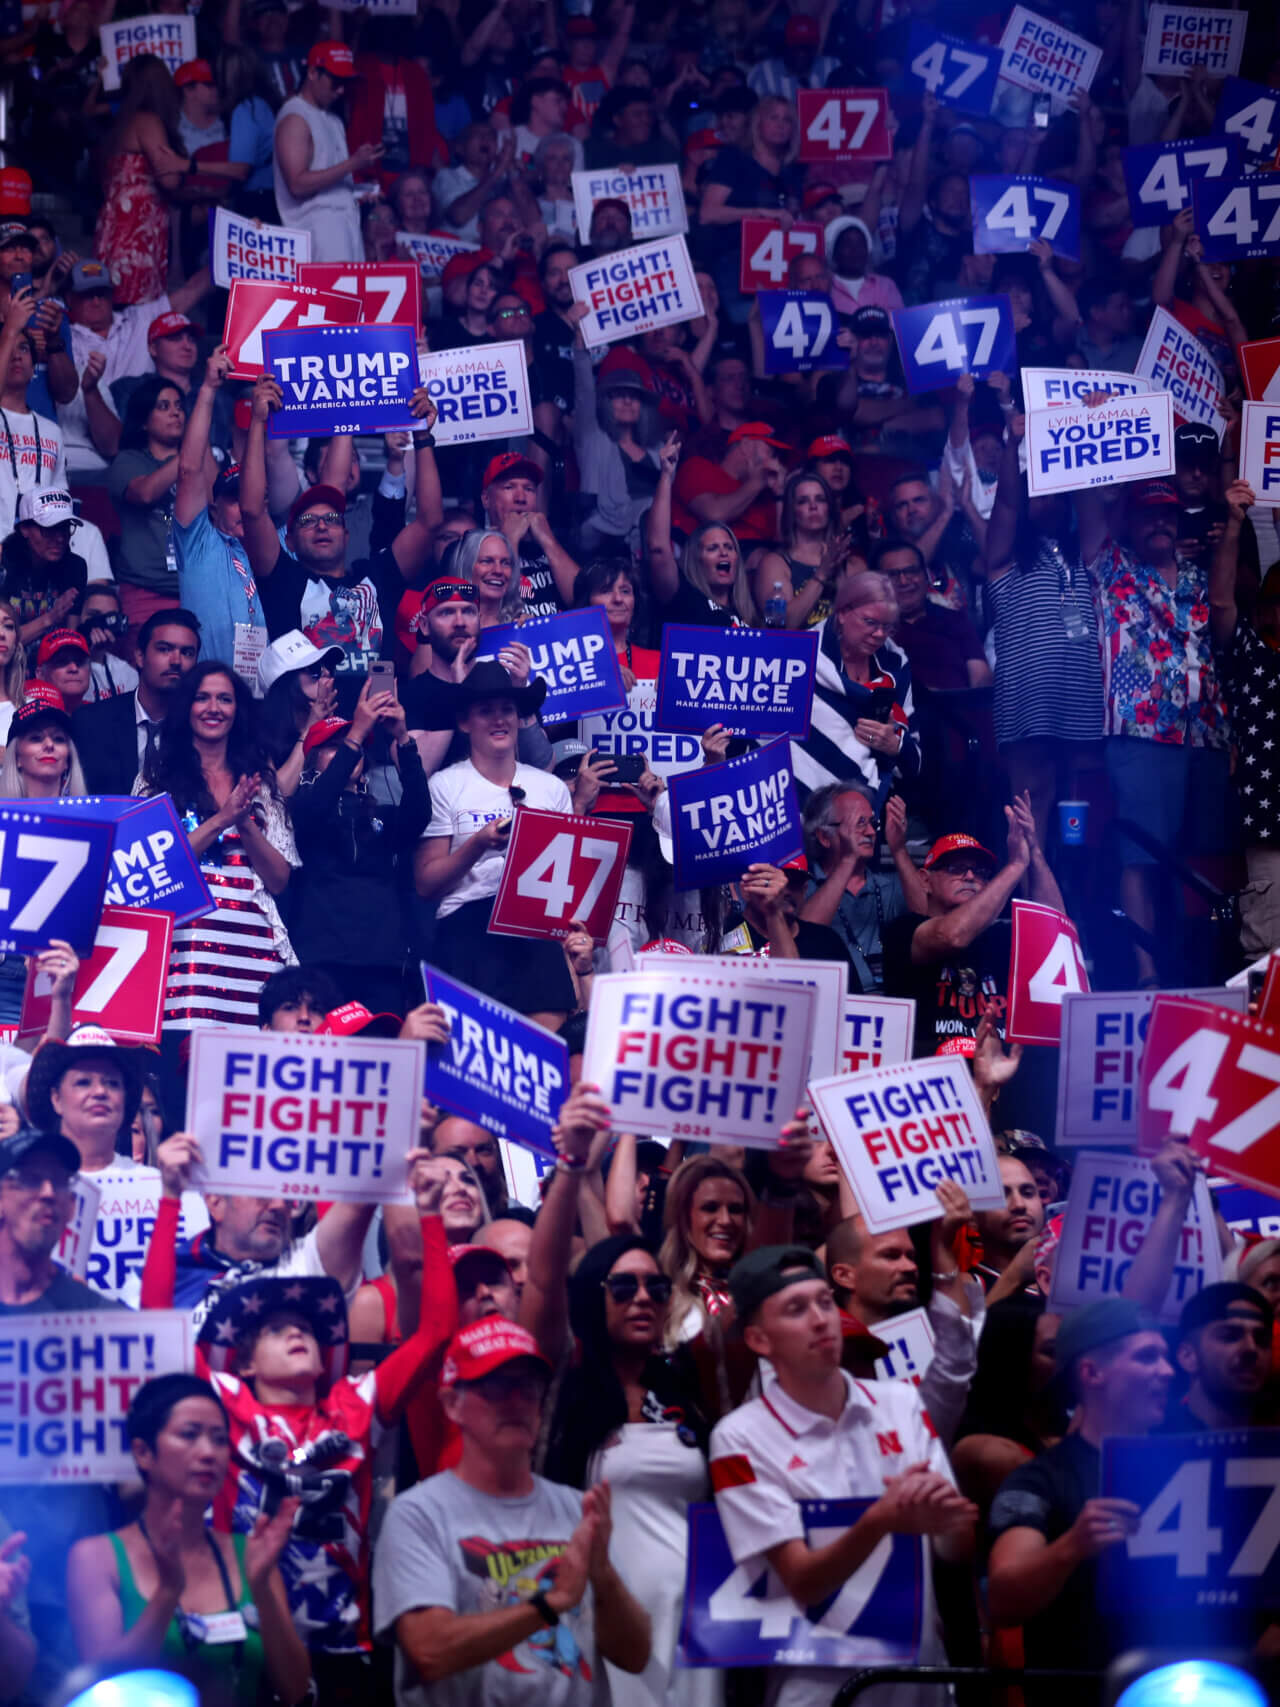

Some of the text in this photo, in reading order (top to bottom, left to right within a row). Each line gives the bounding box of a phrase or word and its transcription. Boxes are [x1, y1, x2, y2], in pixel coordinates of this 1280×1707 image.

[113, 22, 183, 46] FIGHT!
[1020, 19, 1088, 65] FIGHT!
[1160, 32, 1231, 51] FIGHT!
[1162, 13, 1234, 35] FIGHT!
[911, 41, 989, 100] 47
[1006, 51, 1078, 98] FIGHT!
[1013, 35, 1083, 80] FIGHT!
[807, 98, 880, 151] 47
[588, 173, 666, 198] FIGHT!
[985, 185, 1070, 241] 47
[227, 223, 295, 256] FIGHT!
[227, 242, 296, 275] FIGHT!
[585, 251, 673, 290] FIGHT!
[589, 270, 678, 311] FIGHT!
[595, 290, 684, 330] FIGHT!
[772, 300, 833, 360] 47
[914, 306, 1001, 372] 47
[274, 352, 410, 383] TRUMP
[445, 359, 505, 376] KAMALA
[1156, 345, 1222, 409] FIGHT!
[284, 397, 407, 412] MAKE AMERICA GREAT AGAIN!
[290, 375, 399, 402] VANCE
[1151, 362, 1215, 425] FIGHT!
[333, 422, 361, 434] 2024
[452, 431, 477, 442] 2024
[1047, 406, 1150, 429] LYIN' KAMALA
[1047, 417, 1152, 446] YOU'RE
[1040, 434, 1162, 475] FIRED!
[1089, 474, 1115, 485] 2024
[671, 652, 807, 683] TRUMP
[552, 680, 606, 696] GREAT AGAIN!
[675, 700, 795, 713] MAKE AMERICA GREAT AGAIN!
[685, 678, 790, 704] VANCE
[542, 712, 567, 724] 2024
[681, 767, 790, 830] TRUMP
[695, 821, 792, 861] MAKE AMERICA GREAT AGAIN!
[700, 799, 787, 849] VANCE
[516, 831, 619, 923] 47
[620, 993, 788, 1041] FIGHT!
[435, 1000, 563, 1090] TRUMP
[615, 1031, 782, 1082] FIGHT!
[224, 1052, 391, 1097] FIGHT!
[449, 1034, 551, 1114] VANCE
[1147, 1026, 1280, 1155] 47
[221, 1092, 388, 1137] FIGHT!
[611, 1069, 777, 1124] FIGHT!
[844, 1076, 963, 1129] FIGHT!
[479, 1112, 507, 1136] 2024
[671, 1122, 713, 1138] 2024
[861, 1112, 979, 1167] FIGHT!
[218, 1132, 385, 1178] FIGHT!
[281, 1182, 321, 1196] 2024
[876, 1149, 988, 1204] FIGHT!
[459, 1325, 491, 1346] MAKE
[470, 1338, 507, 1357] GREAT
[876, 1429, 904, 1457] N
[1126, 1457, 1280, 1578] 47
[1196, 1590, 1239, 1605] 2024
[773, 1648, 819, 1664] 2024
